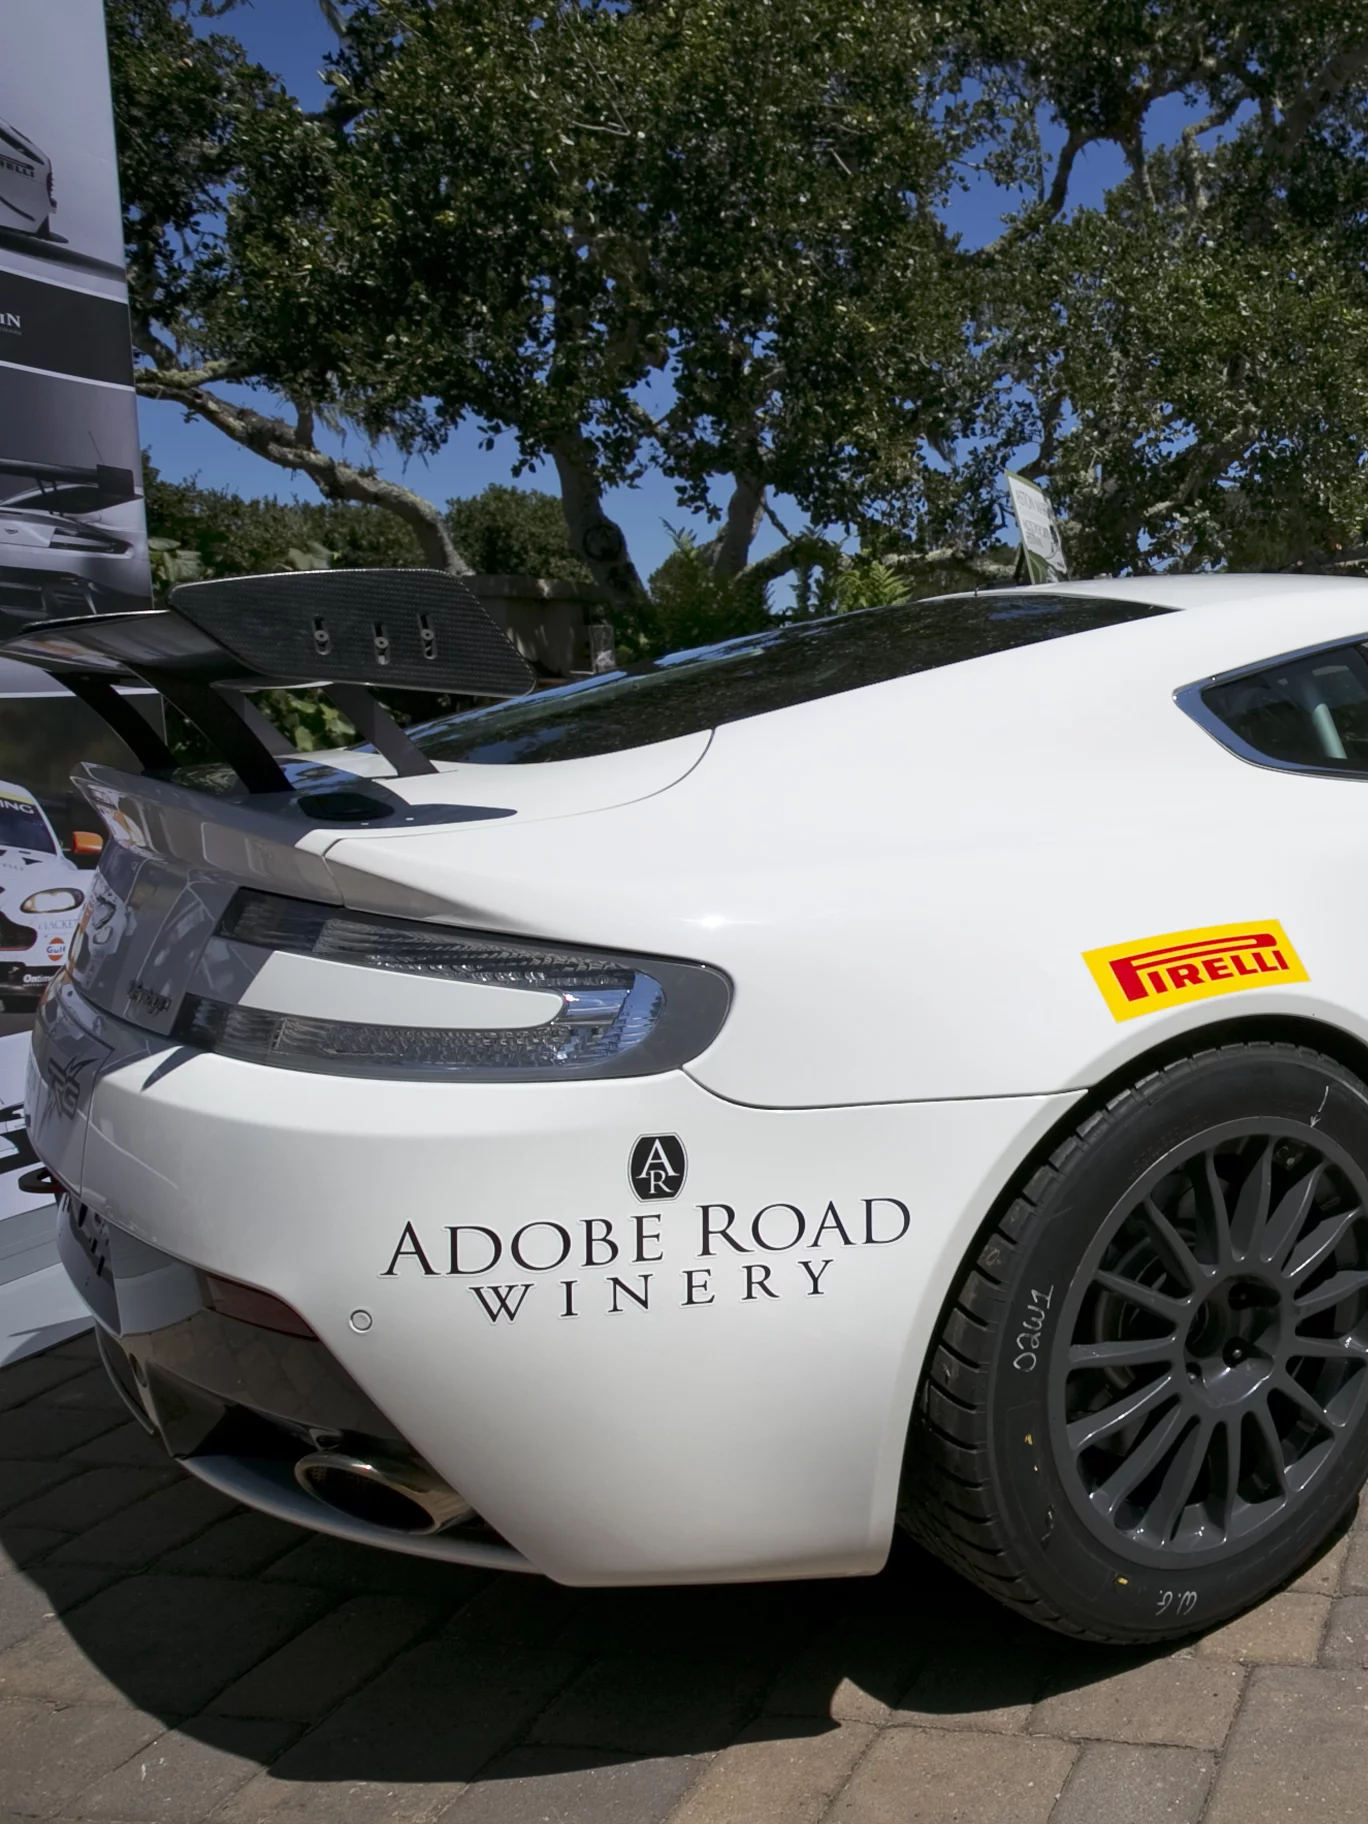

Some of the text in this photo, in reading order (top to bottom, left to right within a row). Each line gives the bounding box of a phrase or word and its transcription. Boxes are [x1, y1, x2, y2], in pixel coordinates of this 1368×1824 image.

[46, 945, 66, 954] Gulf
[1108, 933, 1290, 1002] PIRELLI
[380, 1197, 912, 1277] ADOBE ROAD
[470, 1259, 834, 1323] WINERY
